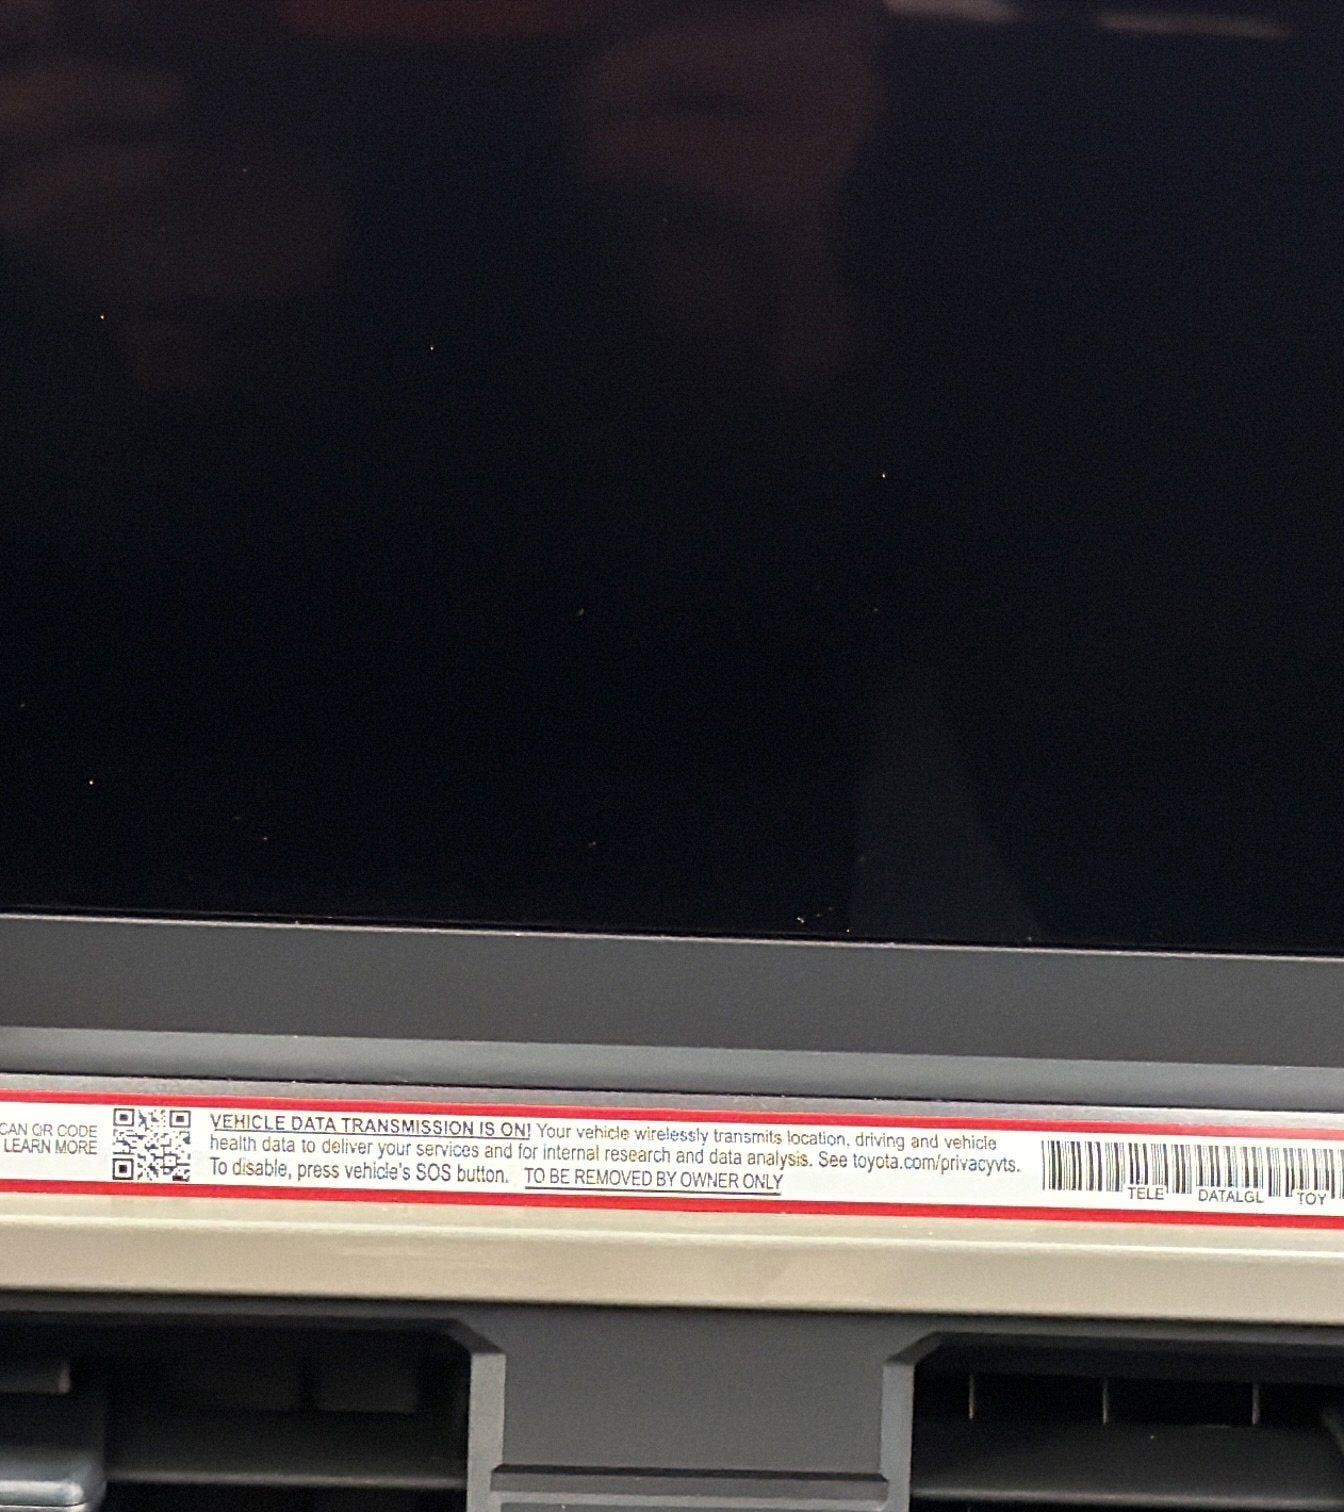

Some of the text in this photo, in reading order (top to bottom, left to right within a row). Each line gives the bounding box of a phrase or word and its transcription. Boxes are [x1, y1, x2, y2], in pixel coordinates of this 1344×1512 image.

[57, 1124, 97, 1138] CODE
[210, 1113, 285, 1130] VEHICLE
[292, 1116, 336, 1132] DATA
[342, 1118, 473, 1135] TRANSMISSION
[480, 1121, 495, 1136] IS
[501, 1122, 531, 1137] ON!
[538, 1123, 571, 1139] Your
[577, 1125, 629, 1140] vehicle
[635, 1126, 708, 1146] wirelessly
[713, 1129, 783, 1144] transmits
[855, 1132, 905, 1151] driving
[911, 1134, 938, 1149] and
[945, 1135, 997, 1150] vehicle
[4, 1138, 51, 1153] LEARN
[55, 1140, 98, 1155] MORE
[210, 1134, 256, 1151] health
[262, 1136, 295, 1152] data
[301, 1137, 315, 1153] to
[322, 1138, 373, 1155] deliver
[378, 1142, 411, 1159] your
[416, 1141, 479, 1158] services
[485, 1142, 512, 1159] and
[518, 1144, 538, 1160] for
[543, 1145, 599, 1162] internal
[605, 1147, 671, 1163] research
[676, 1149, 703, 1164] and
[709, 1150, 742, 1165] data
[748, 1151, 812, 1170] analysis.
[819, 1152, 847, 1167] See
[210, 1157, 784, 1190] To disable, press vehicle's SOS button. TO BE REMOVED BY OWNER ONLY
[1128, 1187, 1327, 1205] TELE DATALGL TOY
